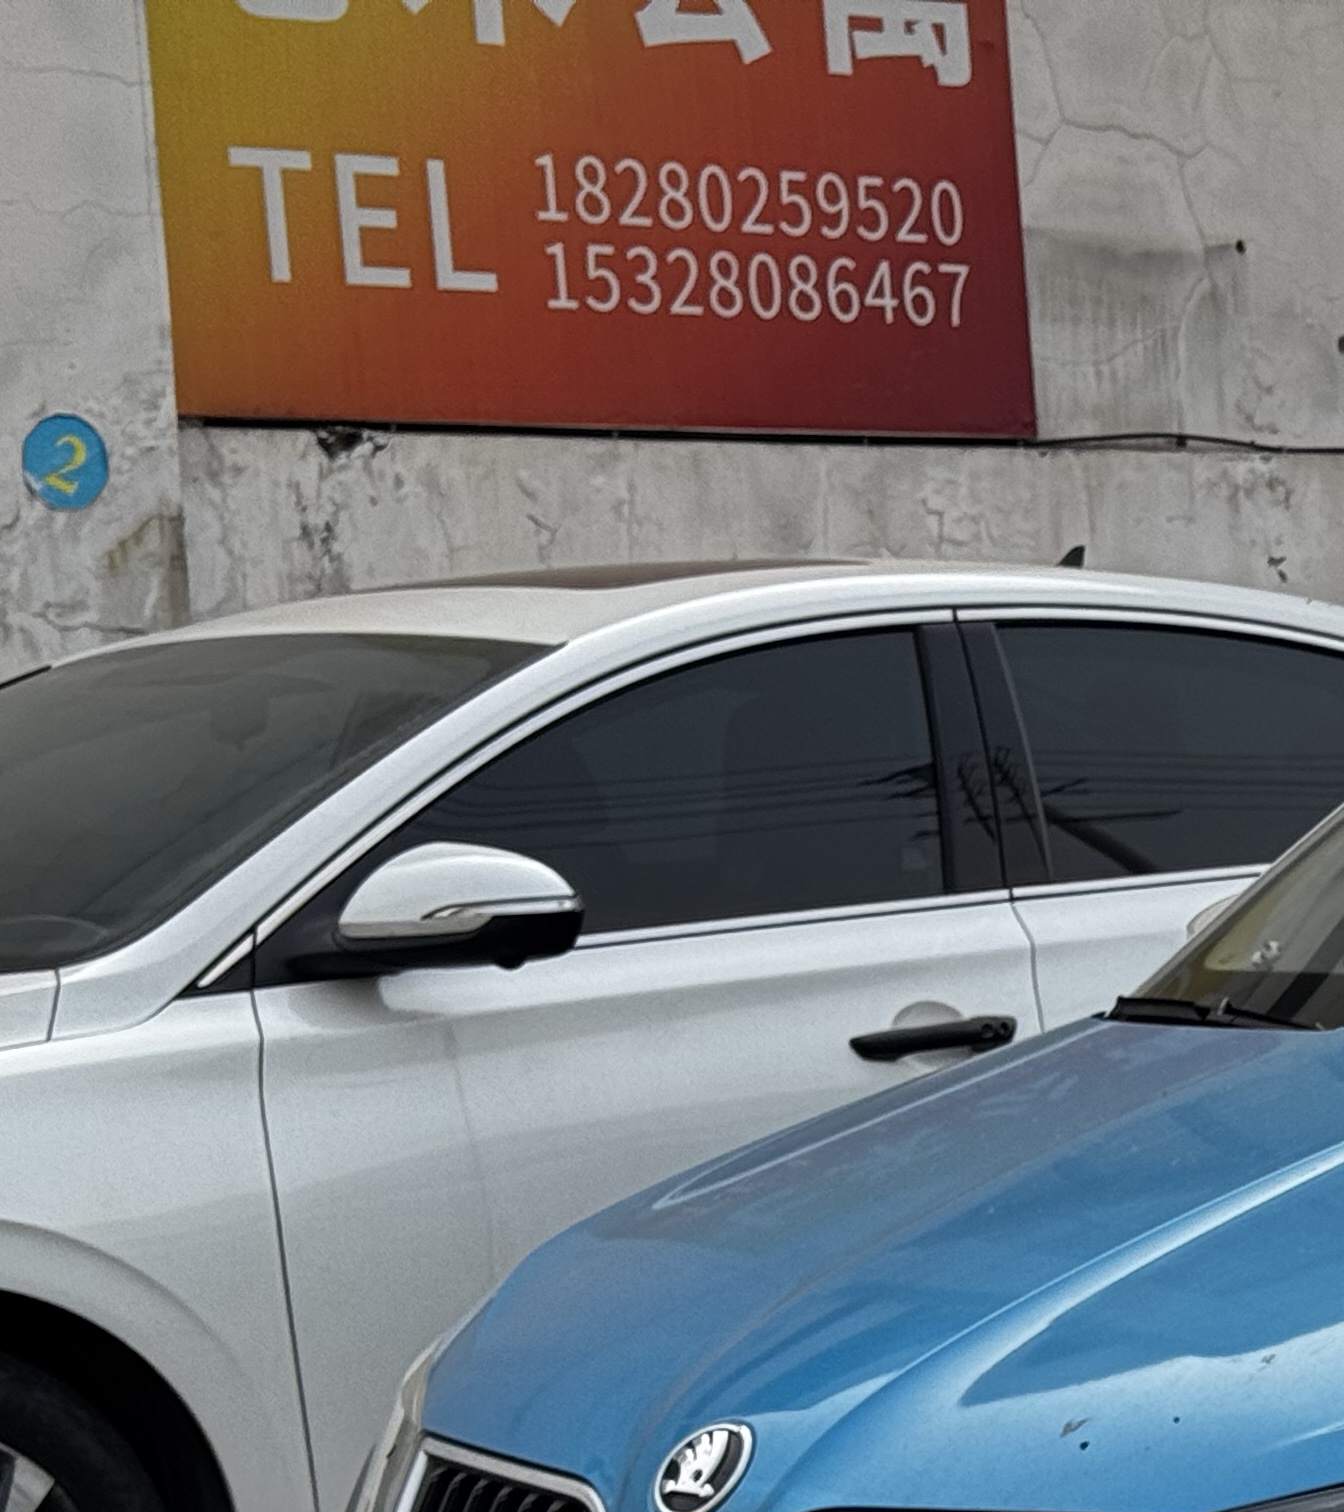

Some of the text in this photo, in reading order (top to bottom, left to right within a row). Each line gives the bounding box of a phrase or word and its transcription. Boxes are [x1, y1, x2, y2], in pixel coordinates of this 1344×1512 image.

[227, 145, 498, 292] TEL
[534, 153, 964, 246] 18280259520
[545, 242, 970, 328] 15328086467
[43, 434, 87, 496] 2
